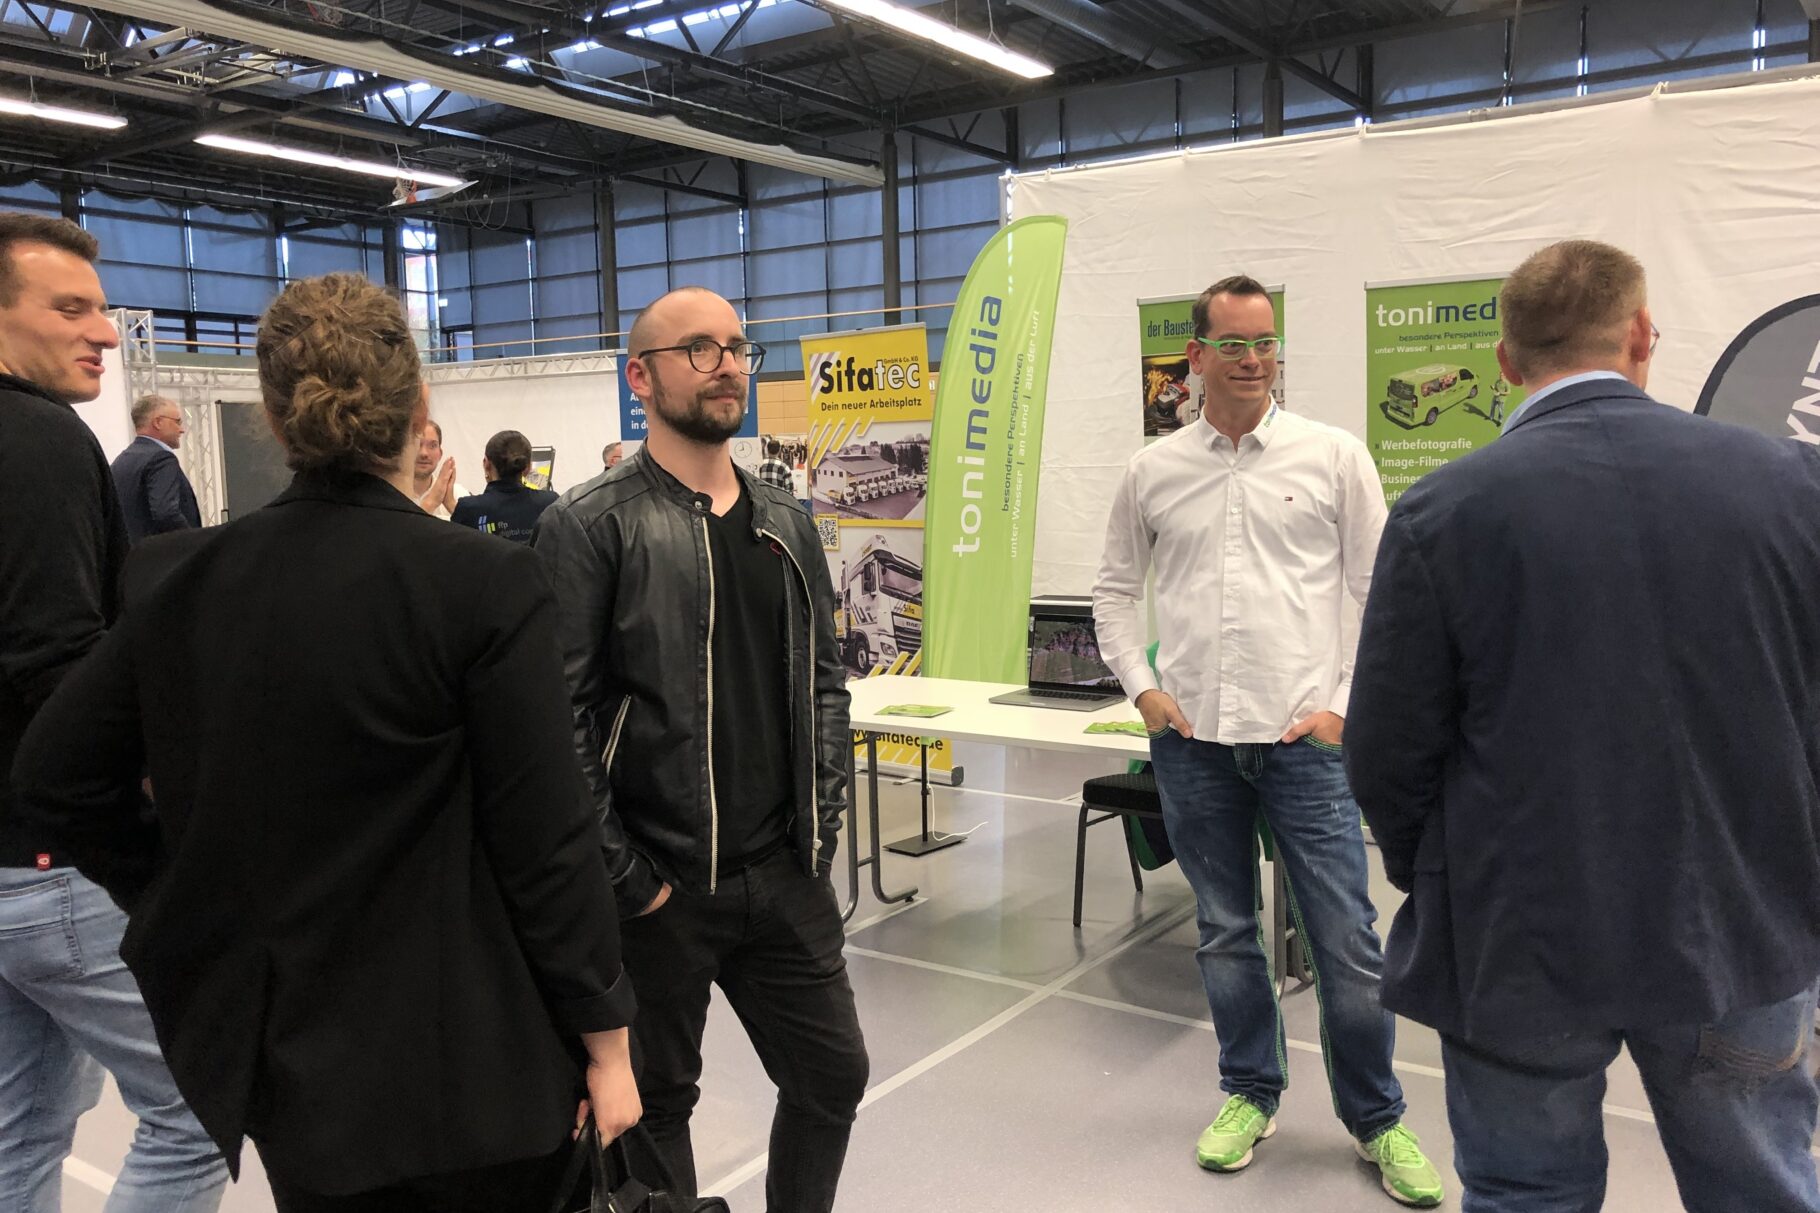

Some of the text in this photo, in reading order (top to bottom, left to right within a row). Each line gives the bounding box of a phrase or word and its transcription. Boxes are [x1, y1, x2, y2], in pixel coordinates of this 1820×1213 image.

[1376, 297, 1498, 327] tonimed
[1030, 311, 1040, 336] Luft
[1147, 319, 1194, 338] der Bauste
[1399, 330, 1499, 342] besondere Perspektiven
[1027, 340, 1036, 362] der
[1397, 344, 1427, 353] Wasser
[820, 356, 920, 394] Sifatec
[1025, 366, 1034, 390] aus
[630, 407, 646, 415] ein
[821, 396, 922, 411] Dein neuer Arbeitsplatz
[631, 420, 639, 429] in
[953, 296, 1002, 557] tonimedia
[1019, 404, 1029, 437] Land
[1002, 353, 1024, 512] besondere Perspektiven
[1019, 440, 1027, 457] an
[1381, 438, 1472, 452] Werbefotografie
[1381, 456, 1449, 470] Image-Filme
[1012, 470, 1023, 521] Wasser
[1011, 523, 1019, 558] unter
